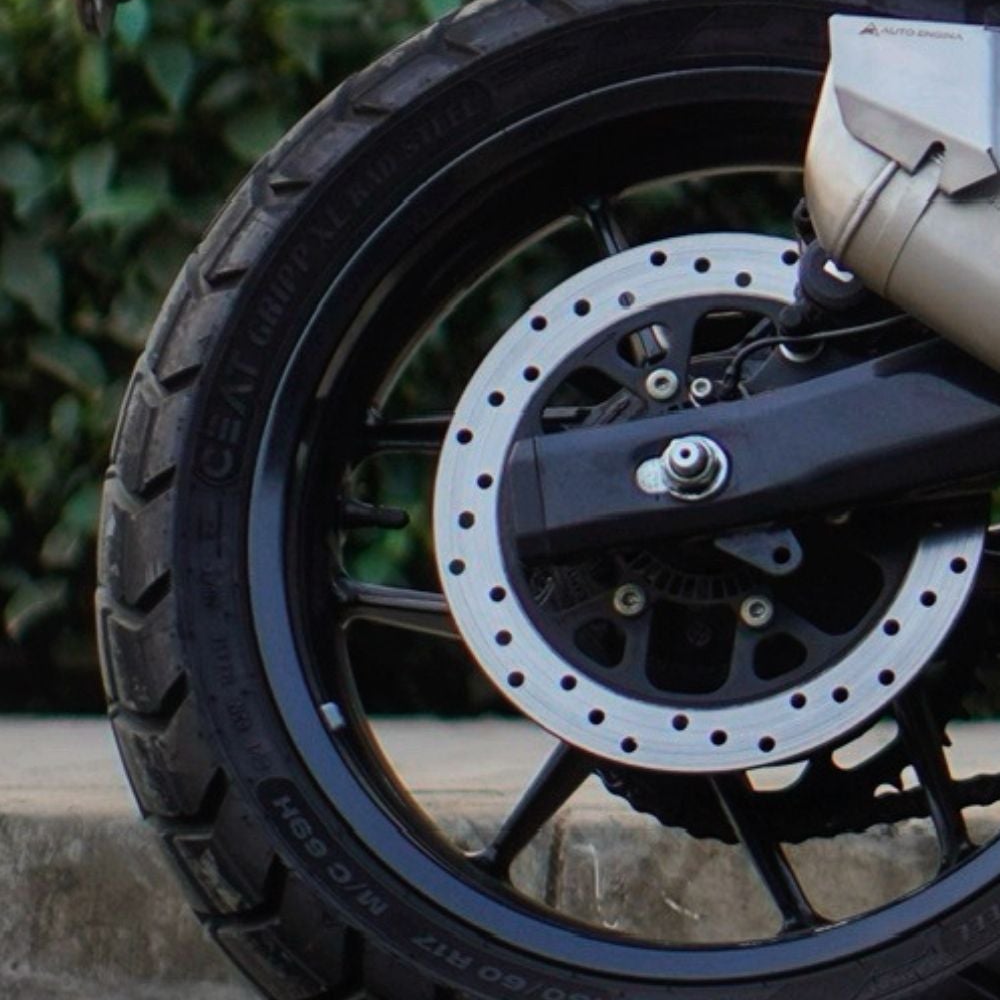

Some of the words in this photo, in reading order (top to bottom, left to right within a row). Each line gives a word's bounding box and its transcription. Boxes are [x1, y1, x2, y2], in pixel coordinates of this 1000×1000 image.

[881, 26, 915, 37] AUTO
[202, 350, 259, 478] CEAT
[271, 796, 329, 859] 69H
[325, 861, 389, 916] M/C
[410, 935, 474, 971] R17
[477, 964, 602, 1000] 0/60
